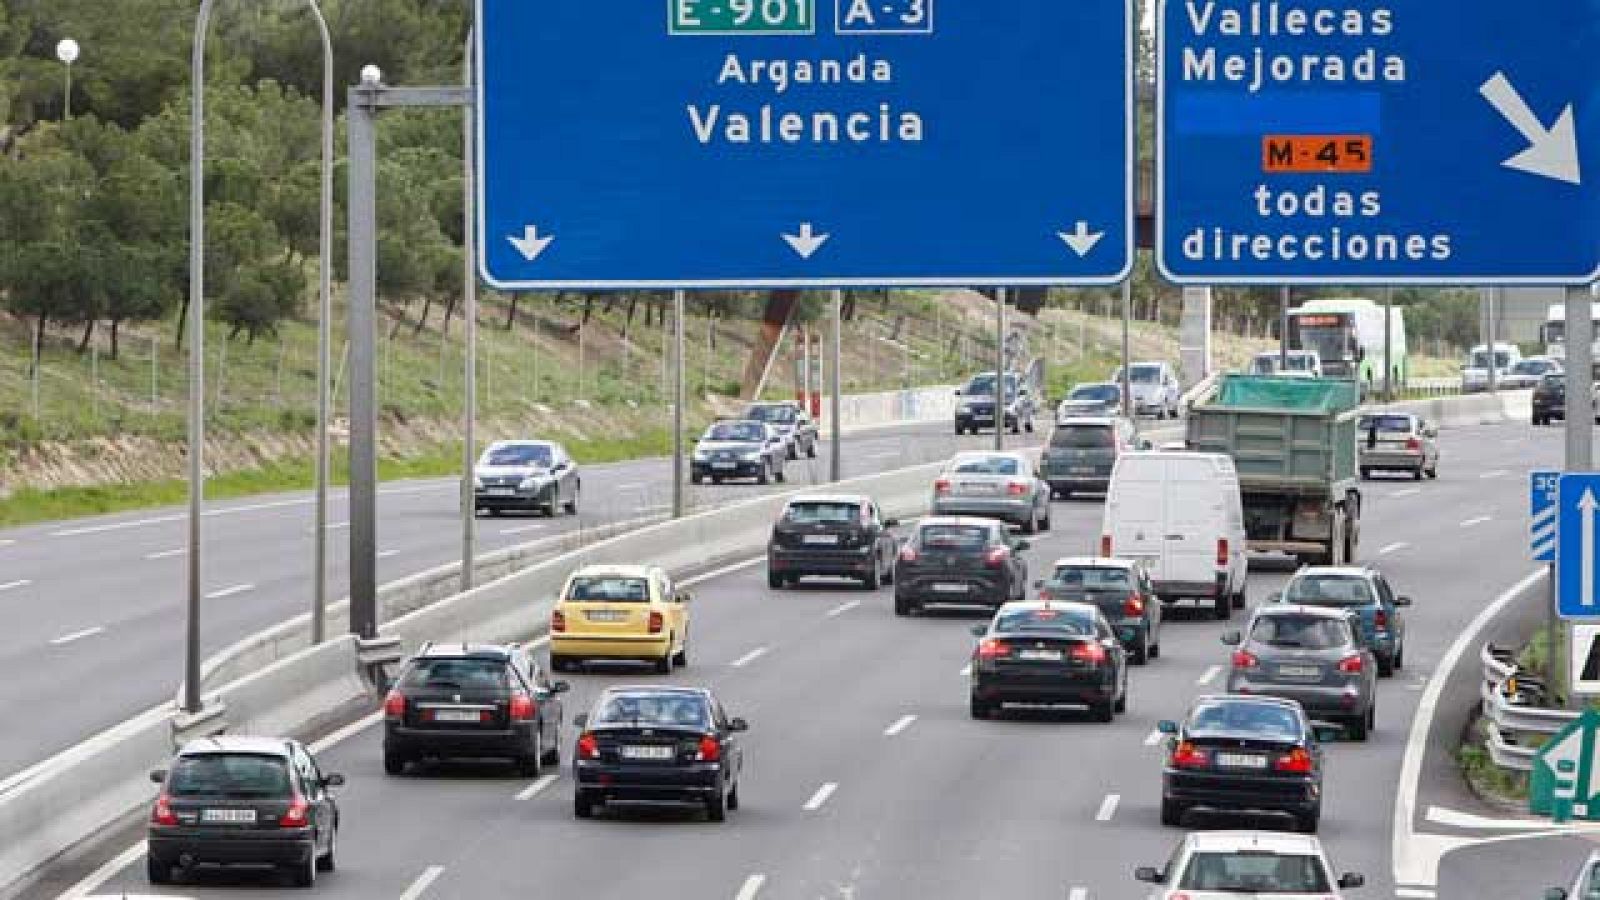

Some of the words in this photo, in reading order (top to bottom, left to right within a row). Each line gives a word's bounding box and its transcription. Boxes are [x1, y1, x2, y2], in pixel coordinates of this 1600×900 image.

[678, 0, 806, 26] E-901
[844, 0, 925, 24] A-3
[1185, 0, 1393, 36] Vallecas
[718, 54, 892, 92] Arganda
[1183, 47, 1406, 92] Mejorada
[687, 104, 922, 142] Valencia
[1269, 139, 1365, 165] M-45
[1255, 184, 1381, 216] todas
[1182, 227, 1452, 261] direcciones
